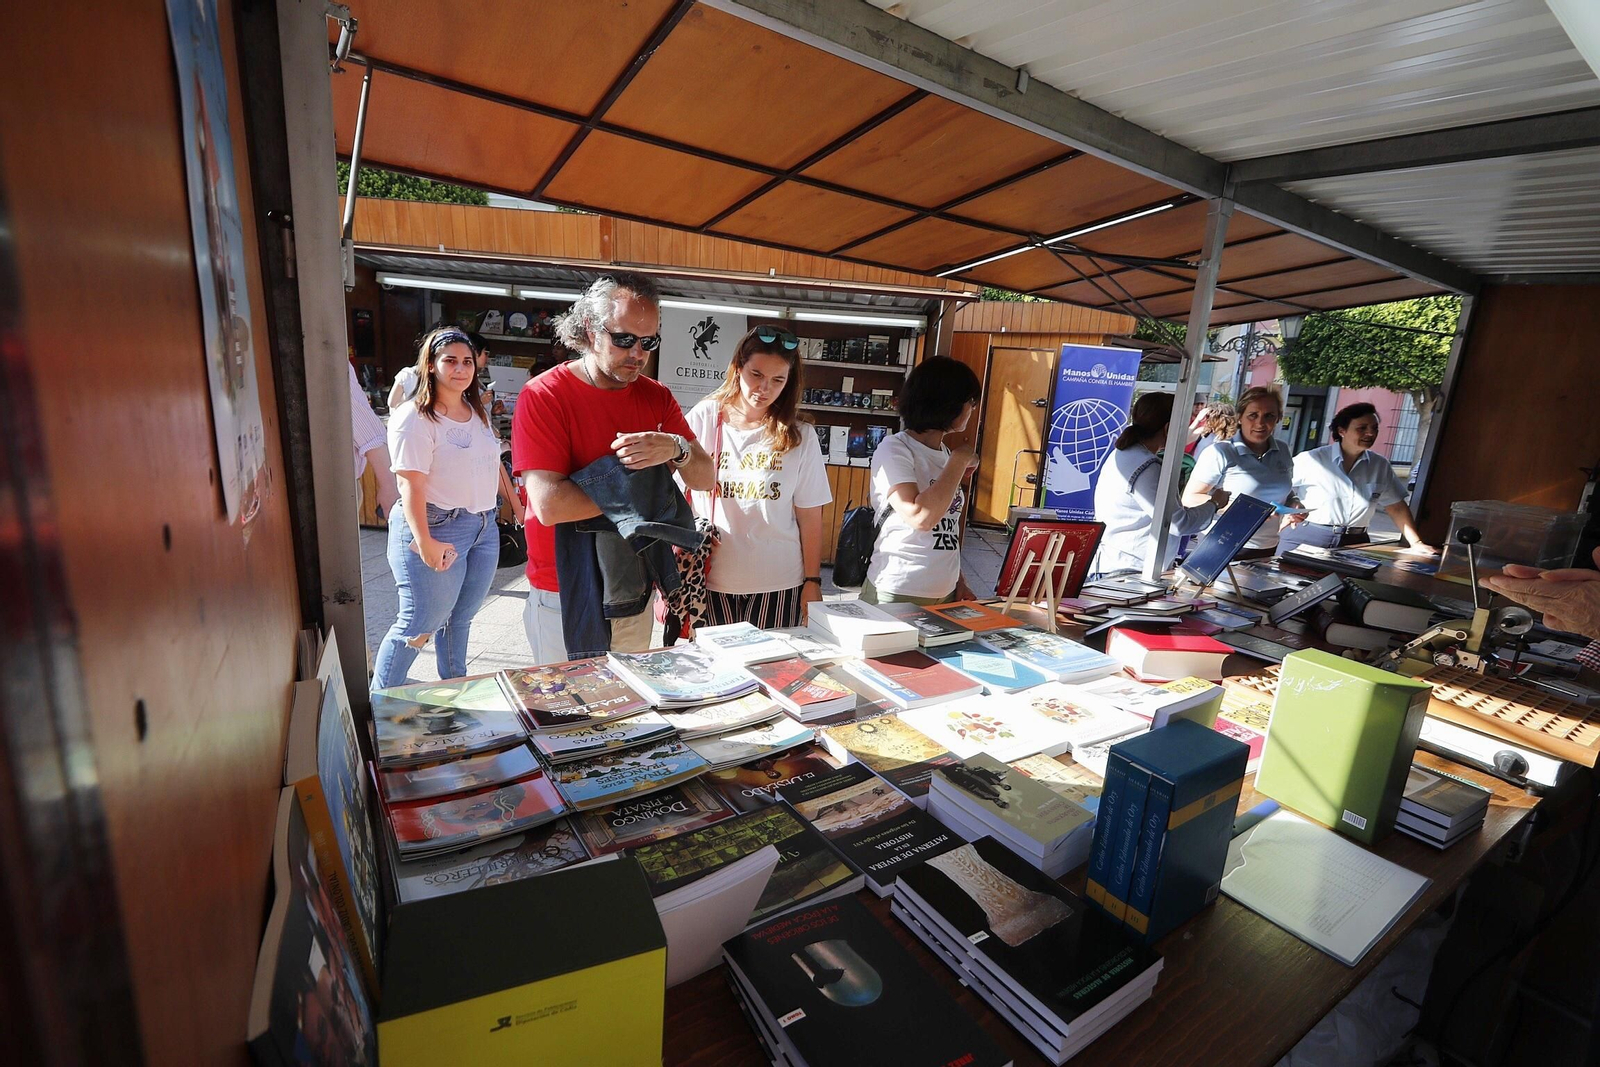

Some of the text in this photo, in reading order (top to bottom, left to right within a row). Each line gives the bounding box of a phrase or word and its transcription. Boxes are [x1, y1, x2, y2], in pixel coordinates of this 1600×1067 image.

[1062, 368, 1136, 381] Manos Unidas
[1062, 375, 1087, 384] CAMPAÑA
[1087, 377, 1108, 386] CONTRA
[402, 730, 500, 750] TRAFALGAR
[571, 731, 627, 746] CUEVAS
[595, 761, 667, 784] FRANCESES
[631, 767, 675, 783] PINAR
[740, 775, 803, 799] DESEADO
[610, 798, 661, 817] PIÑATA
[611, 801, 689, 828] DOMINGO
[874, 831, 914, 851] HISTORIA
[901, 842, 910, 850] EN
[868, 834, 949, 872] PATERNA DE RIVERA
[423, 846, 561, 886] GUERRILLEROS
[750, 919, 792, 940] MEDIEVAL
[809, 918, 827, 929] LOS
[826, 914, 838, 925] DE
[1072, 957, 1134, 1000] HISTORIA DE ALGECIRAS
